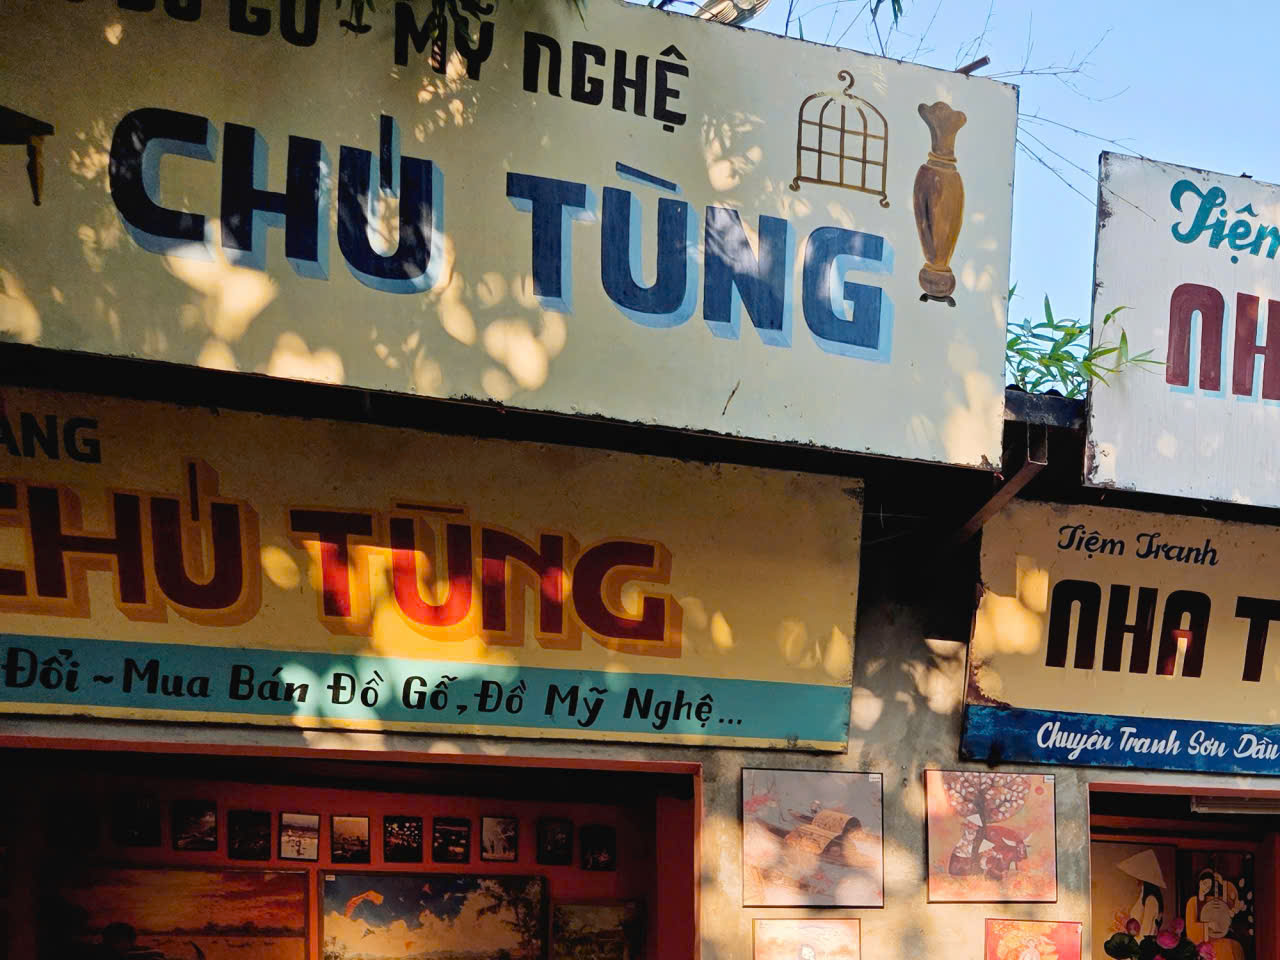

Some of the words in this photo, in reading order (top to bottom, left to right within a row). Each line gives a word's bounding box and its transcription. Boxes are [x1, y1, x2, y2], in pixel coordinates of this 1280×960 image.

[523, 45, 689, 133] NGHỆ
[506, 162, 893, 362] TÙNG
[288, 500, 683, 658] TÙNG
[1057, 524, 1126, 560] Tiệm
[1135, 532, 1220, 567] Tranh
[1045, 579, 1212, 679] NHA
[0, 647, 80, 692] Đổi
[122, 657, 211, 698] Mua
[228, 664, 309, 703] Bán
[326, 670, 384, 708] Đồ
[544, 683, 608, 728] Mỹ
[1036, 721, 1114, 761] Chuyên
[1119, 726, 1182, 756] Tranh
[1188, 729, 1229, 758] Sơn
[1233, 733, 1280, 760] Dầu
